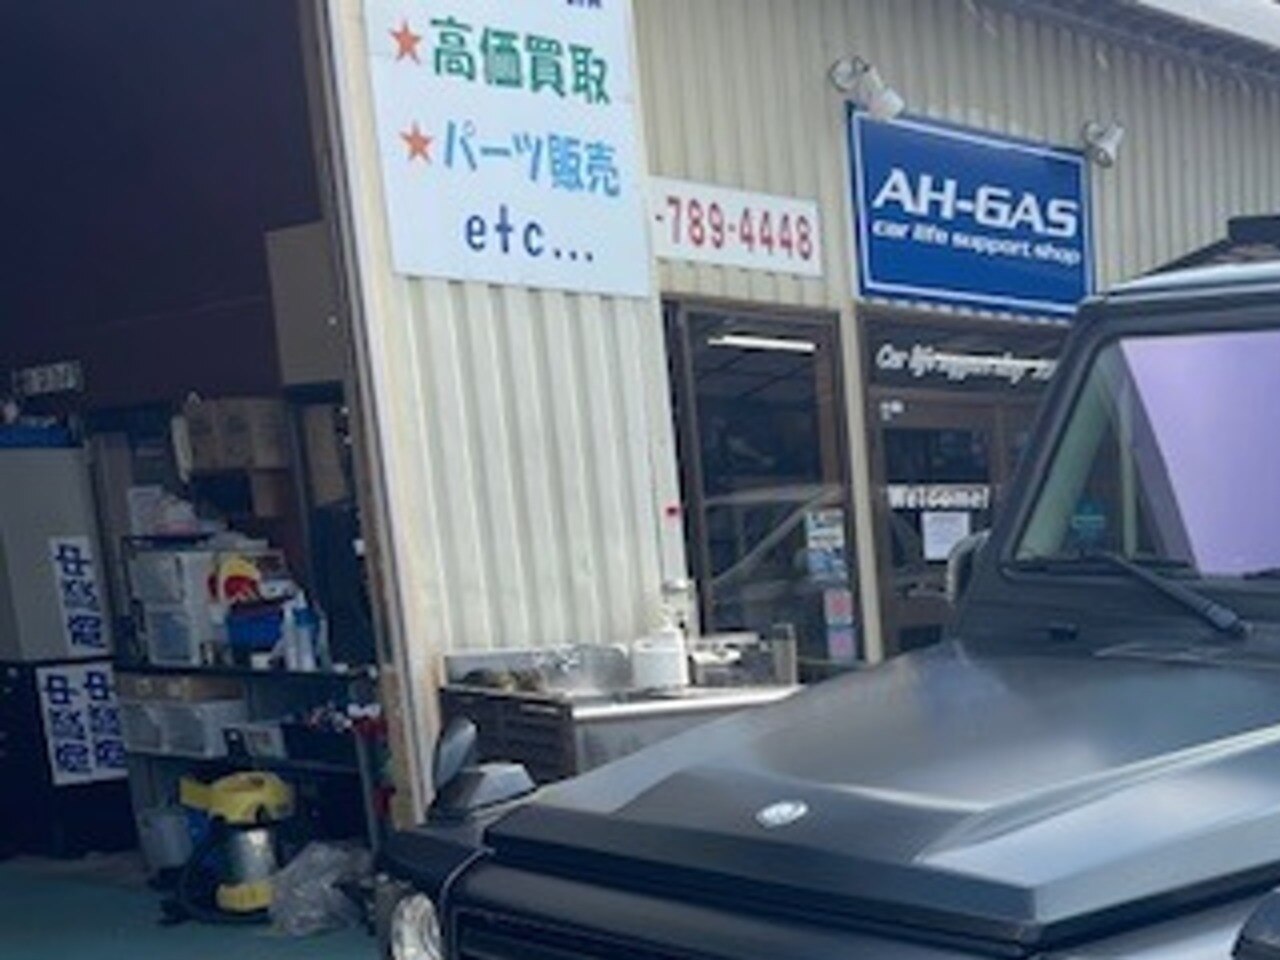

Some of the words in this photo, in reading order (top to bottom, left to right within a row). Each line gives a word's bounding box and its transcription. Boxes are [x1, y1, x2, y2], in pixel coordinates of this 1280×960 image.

[429, 16, 611, 104] 高価買取
[444, 119, 621, 197] パーツ販売
[465, 203, 593, 262] etc...
[872, 167, 1078, 238] AH-GAS
[952, 231, 1032, 258] support
